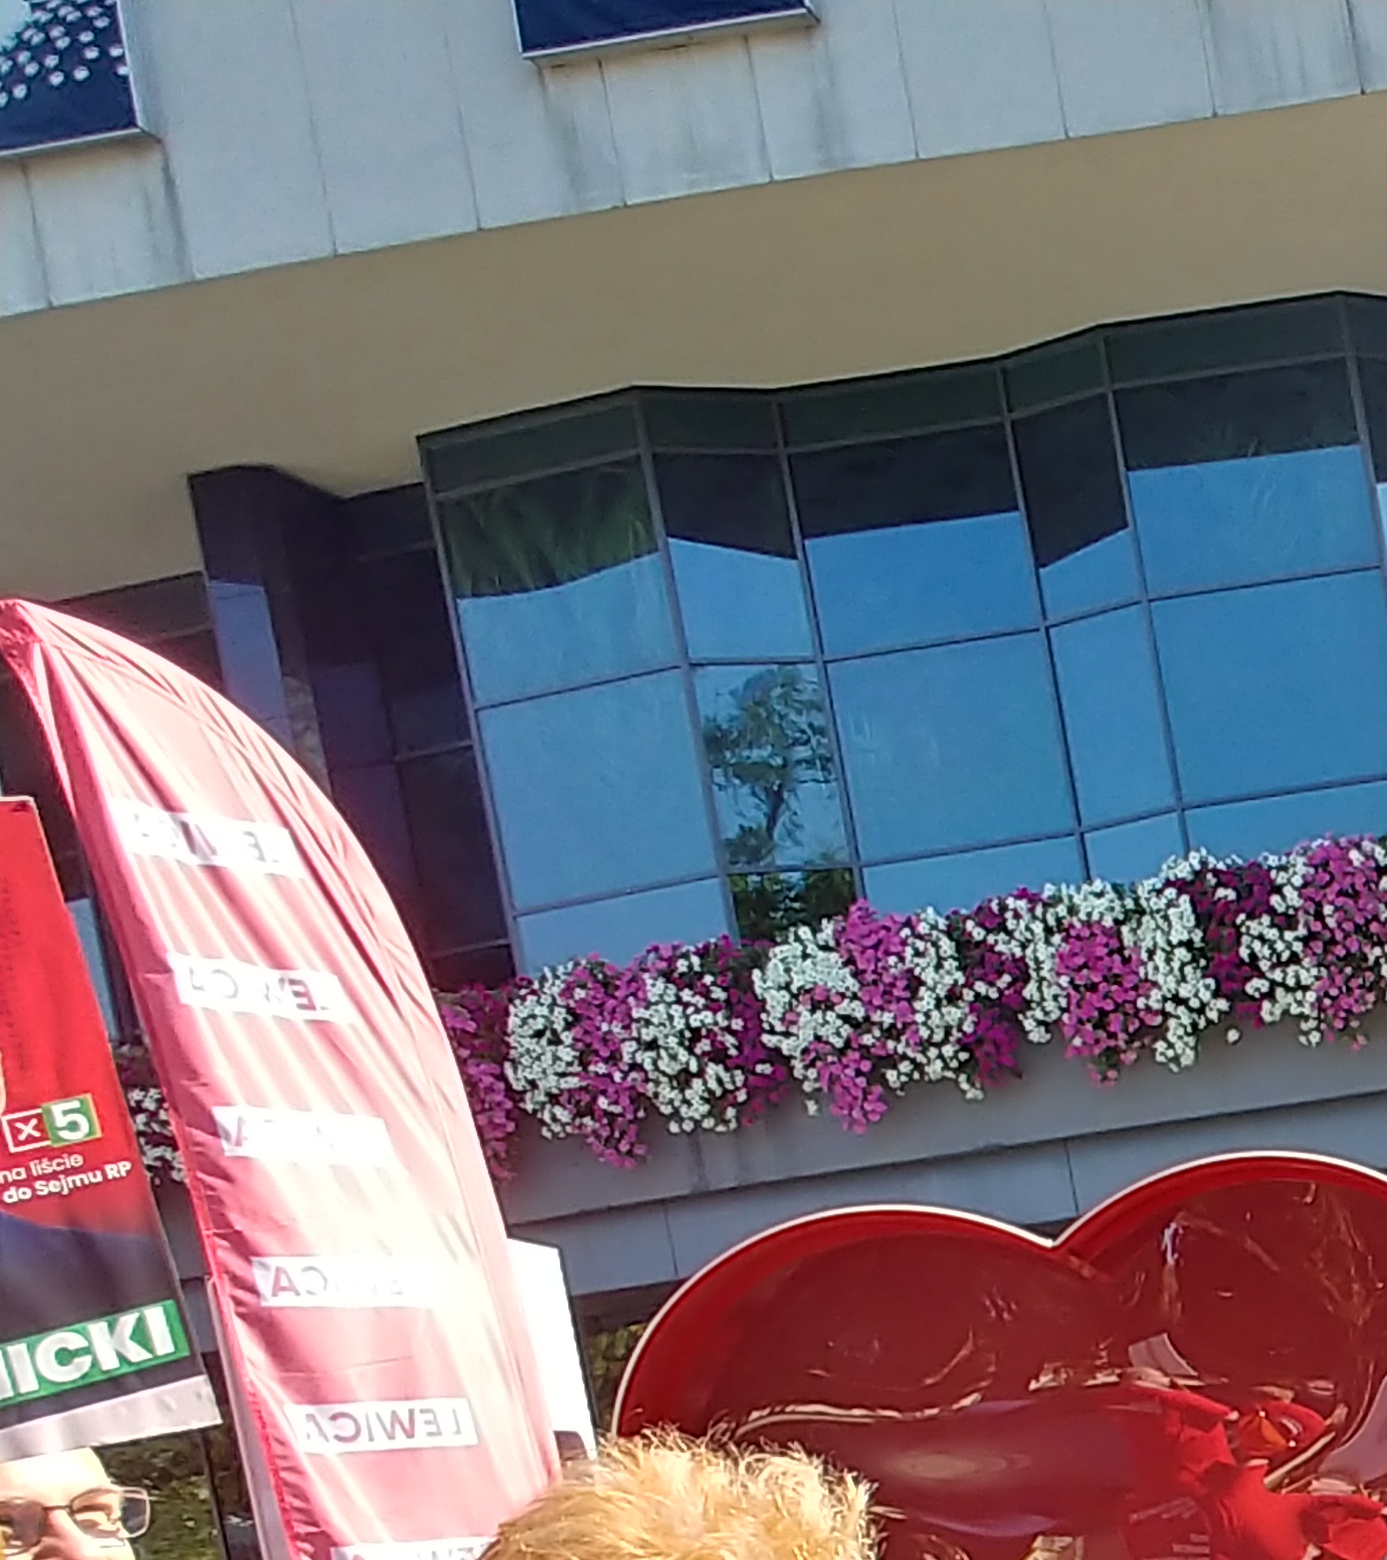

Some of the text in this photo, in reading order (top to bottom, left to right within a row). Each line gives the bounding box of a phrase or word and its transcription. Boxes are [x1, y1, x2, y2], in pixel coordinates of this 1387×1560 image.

[3, 1160, 132, 1203] do Sejmu RP
[30, 1153, 84, 1178] liście
